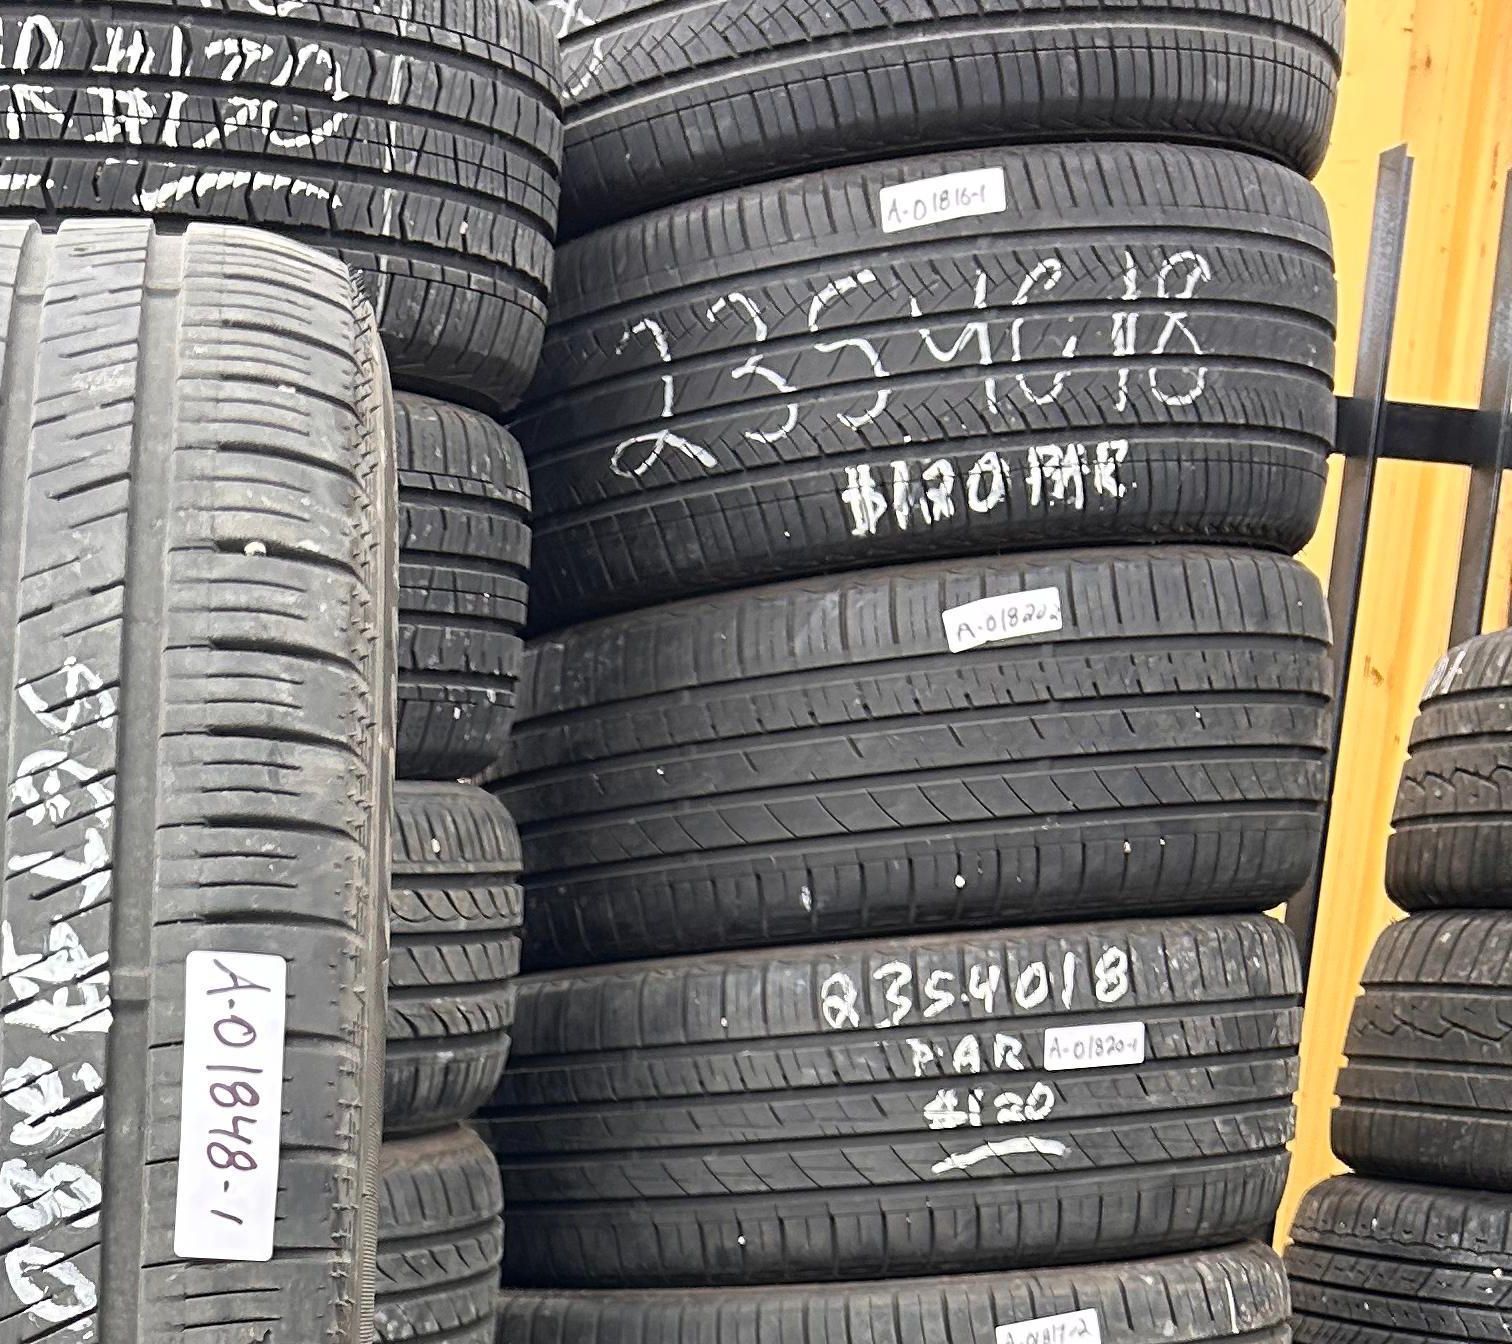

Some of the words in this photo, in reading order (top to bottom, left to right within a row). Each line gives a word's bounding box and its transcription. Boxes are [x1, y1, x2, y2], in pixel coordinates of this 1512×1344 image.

[888, 184, 986, 223] A-01816-1
[905, 1033, 1025, 1077] PAR
[1049, 1035, 1138, 1059] A-01820-1
[204, 959, 273, 1226] A-01848-1
